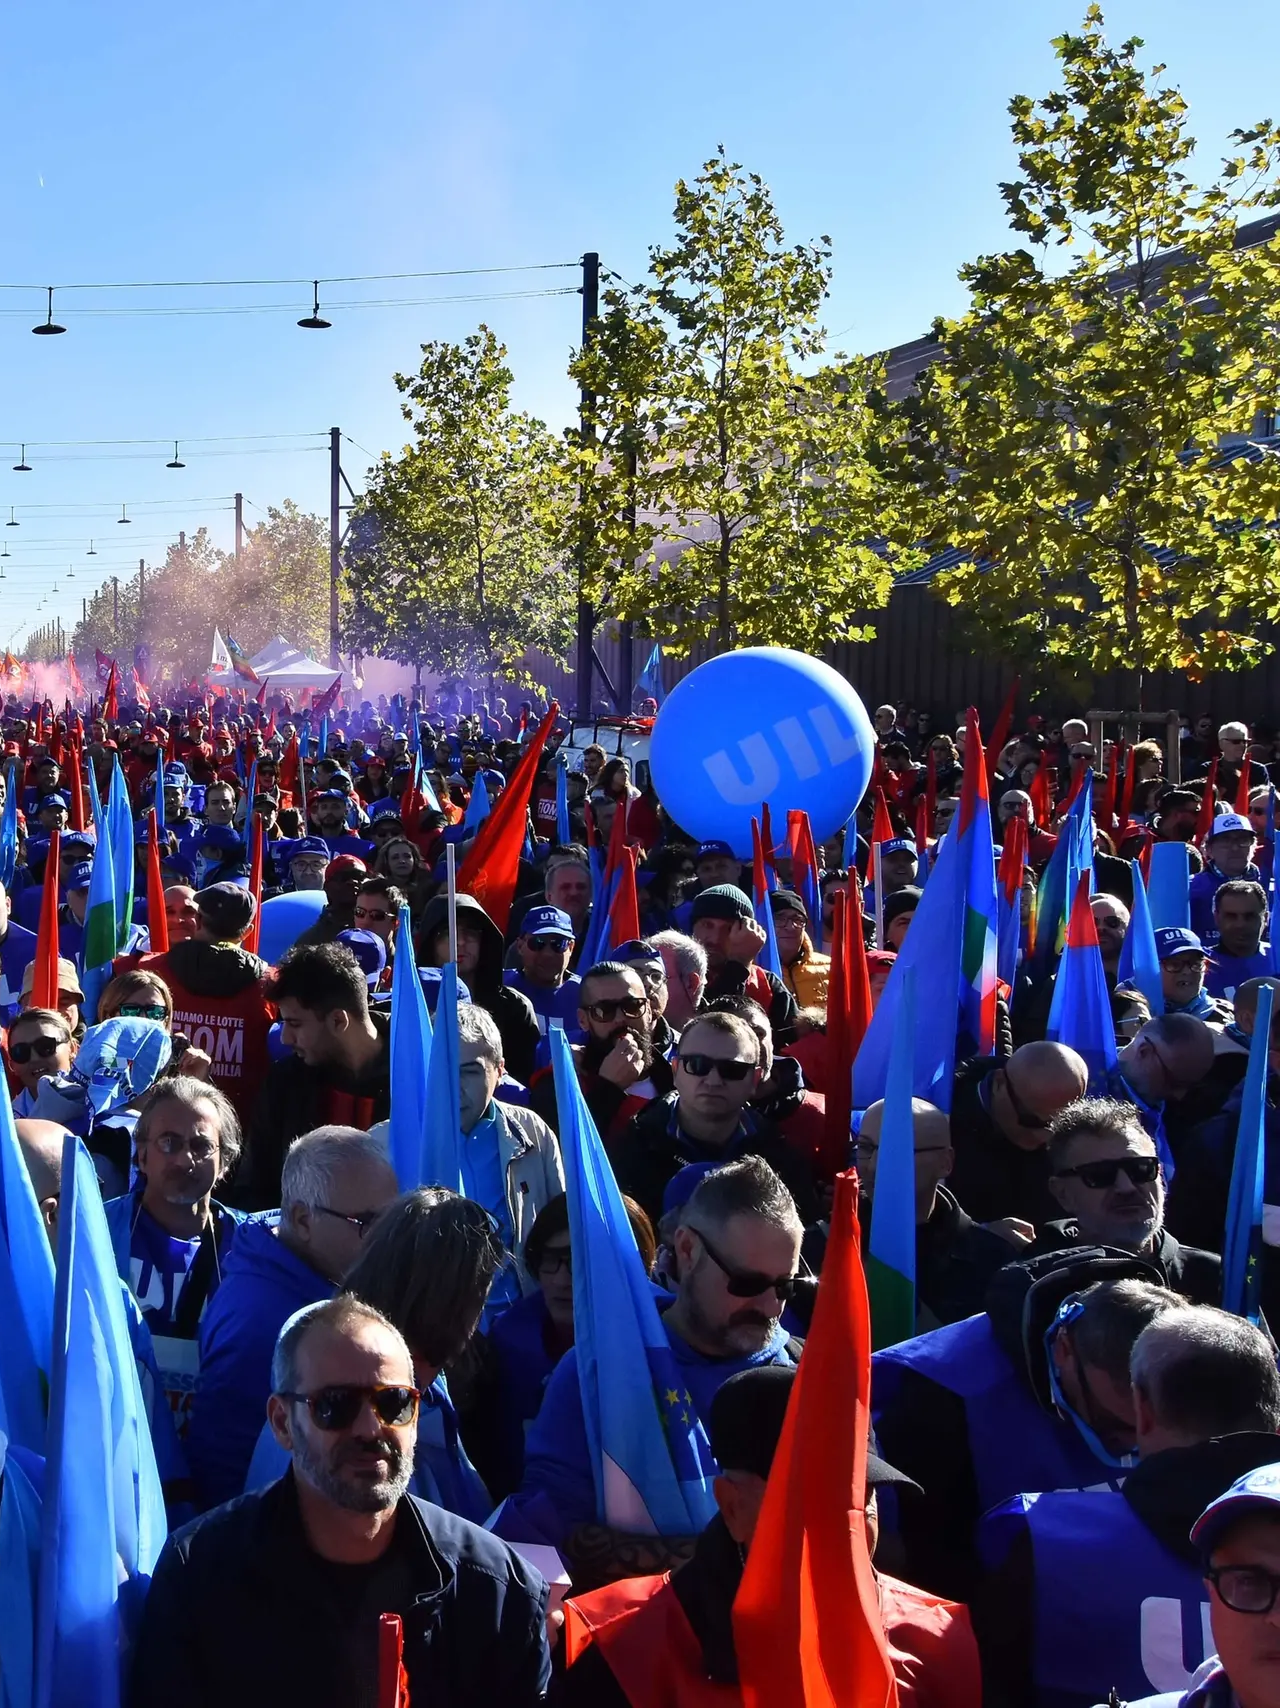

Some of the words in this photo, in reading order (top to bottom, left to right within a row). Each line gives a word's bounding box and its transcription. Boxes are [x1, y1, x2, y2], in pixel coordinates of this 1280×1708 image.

[702, 703, 862, 806] UIL
[173, 1010, 203, 1024] NIAMO
[205, 1014, 216, 1026] LE
[216, 1016, 244, 1028] LOTTE
